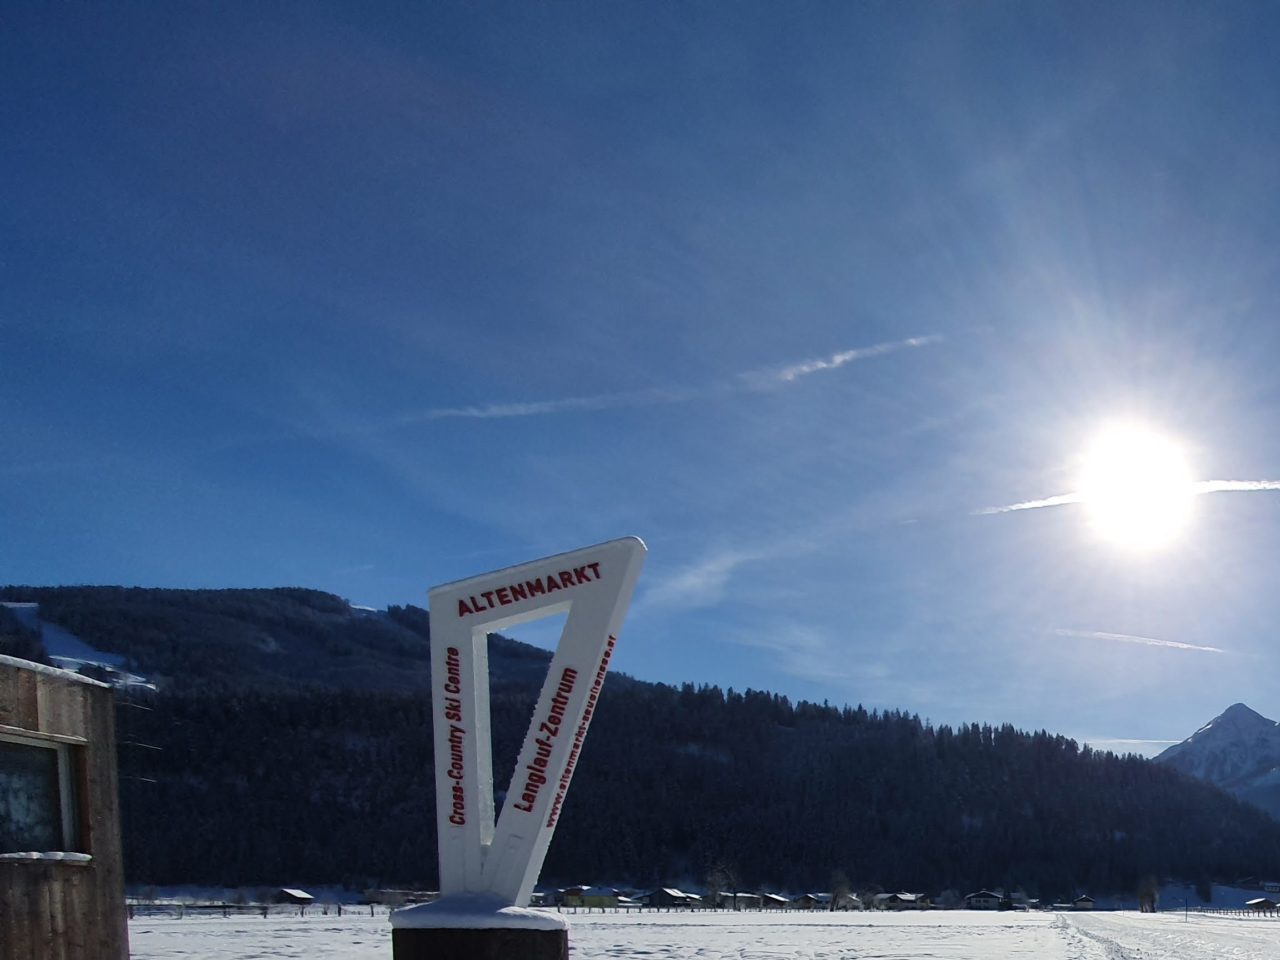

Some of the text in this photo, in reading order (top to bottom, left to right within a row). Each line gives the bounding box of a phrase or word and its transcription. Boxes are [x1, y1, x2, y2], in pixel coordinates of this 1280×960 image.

[458, 562, 601, 617] ALTENMARKT
[444, 646, 467, 826] Cross-Country Ski Centre
[513, 667, 579, 813] Langlauf-Zentrum
